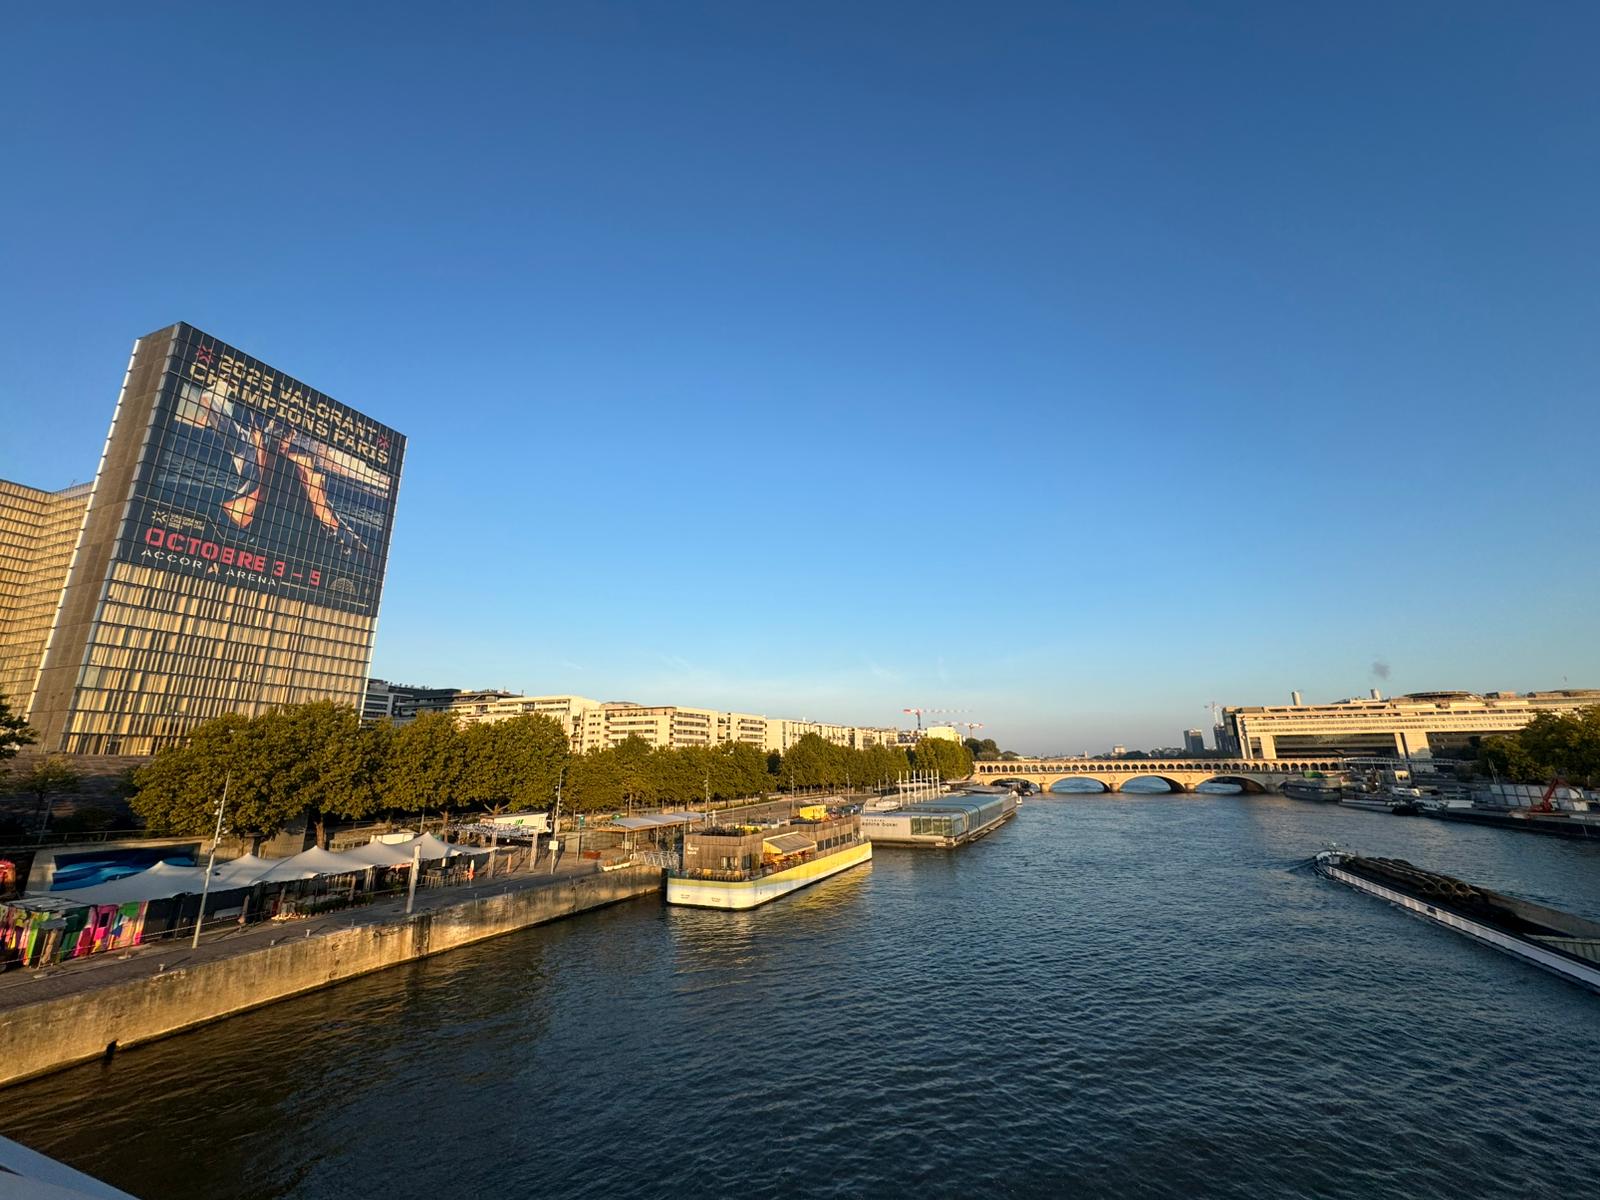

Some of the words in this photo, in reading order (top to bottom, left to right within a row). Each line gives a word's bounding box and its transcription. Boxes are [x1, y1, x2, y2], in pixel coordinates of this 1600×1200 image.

[189, 361, 328, 436] CHAMPIONS
[333, 427, 388, 464] PARIS
[219, 353, 274, 393] 2025
[280, 382, 377, 441] VALORANT
[141, 549, 203, 569] ACCOR
[225, 568, 276, 587] ARENA
[145, 527, 266, 573] OCTOBRE
[273, 560, 286, 577] 3
[310, 569, 321, 586] 5
